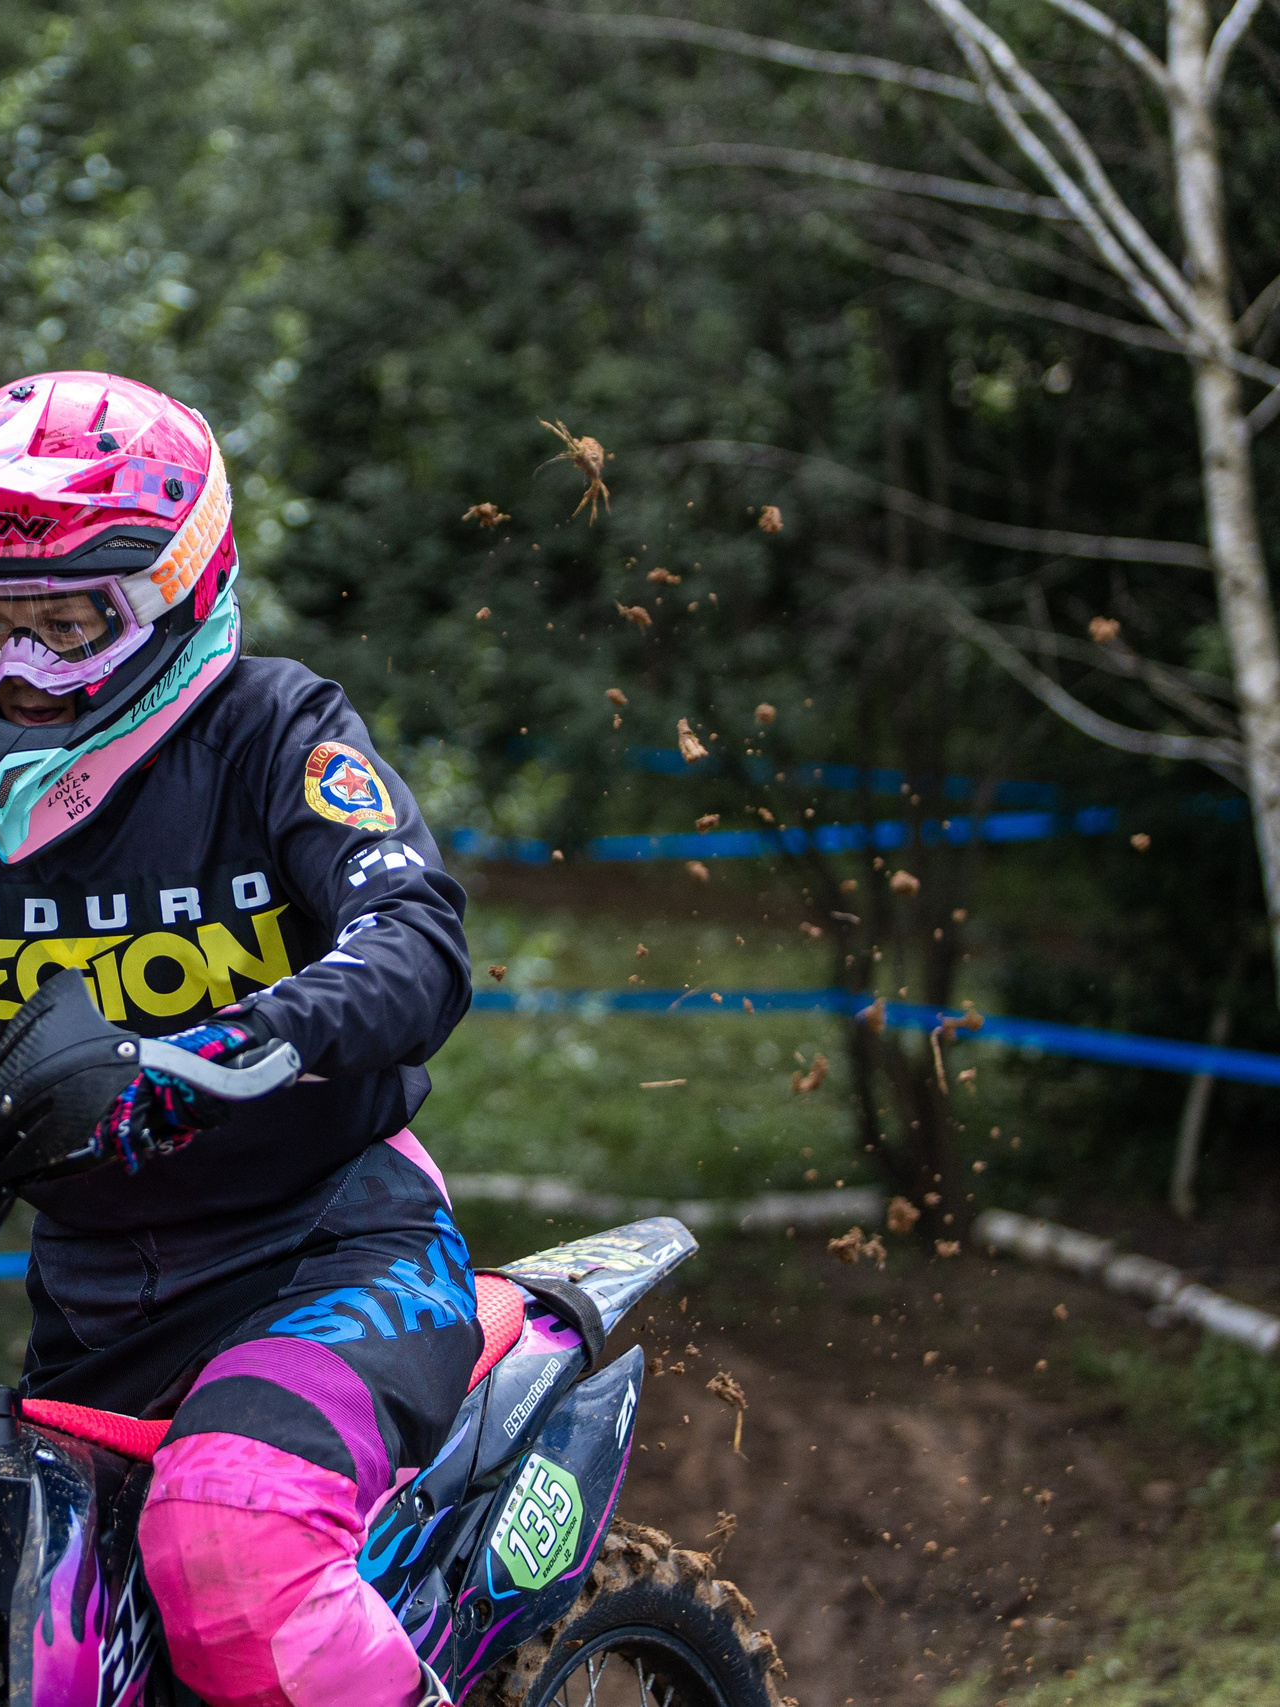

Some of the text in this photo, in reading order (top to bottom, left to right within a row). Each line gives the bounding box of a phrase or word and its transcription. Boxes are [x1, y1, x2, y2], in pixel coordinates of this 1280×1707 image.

[150, 524, 201, 584] ONE
[47, 772, 90, 807] LOVES
[63, 789, 85, 808] ME
[66, 796, 91, 820] NOT
[504, 1359, 560, 1438] BSEmoto.pro
[508, 1466, 572, 1579] 135
[542, 1516, 577, 1579] ENDURO JUNIOR
[564, 1548, 572, 1563] J2
